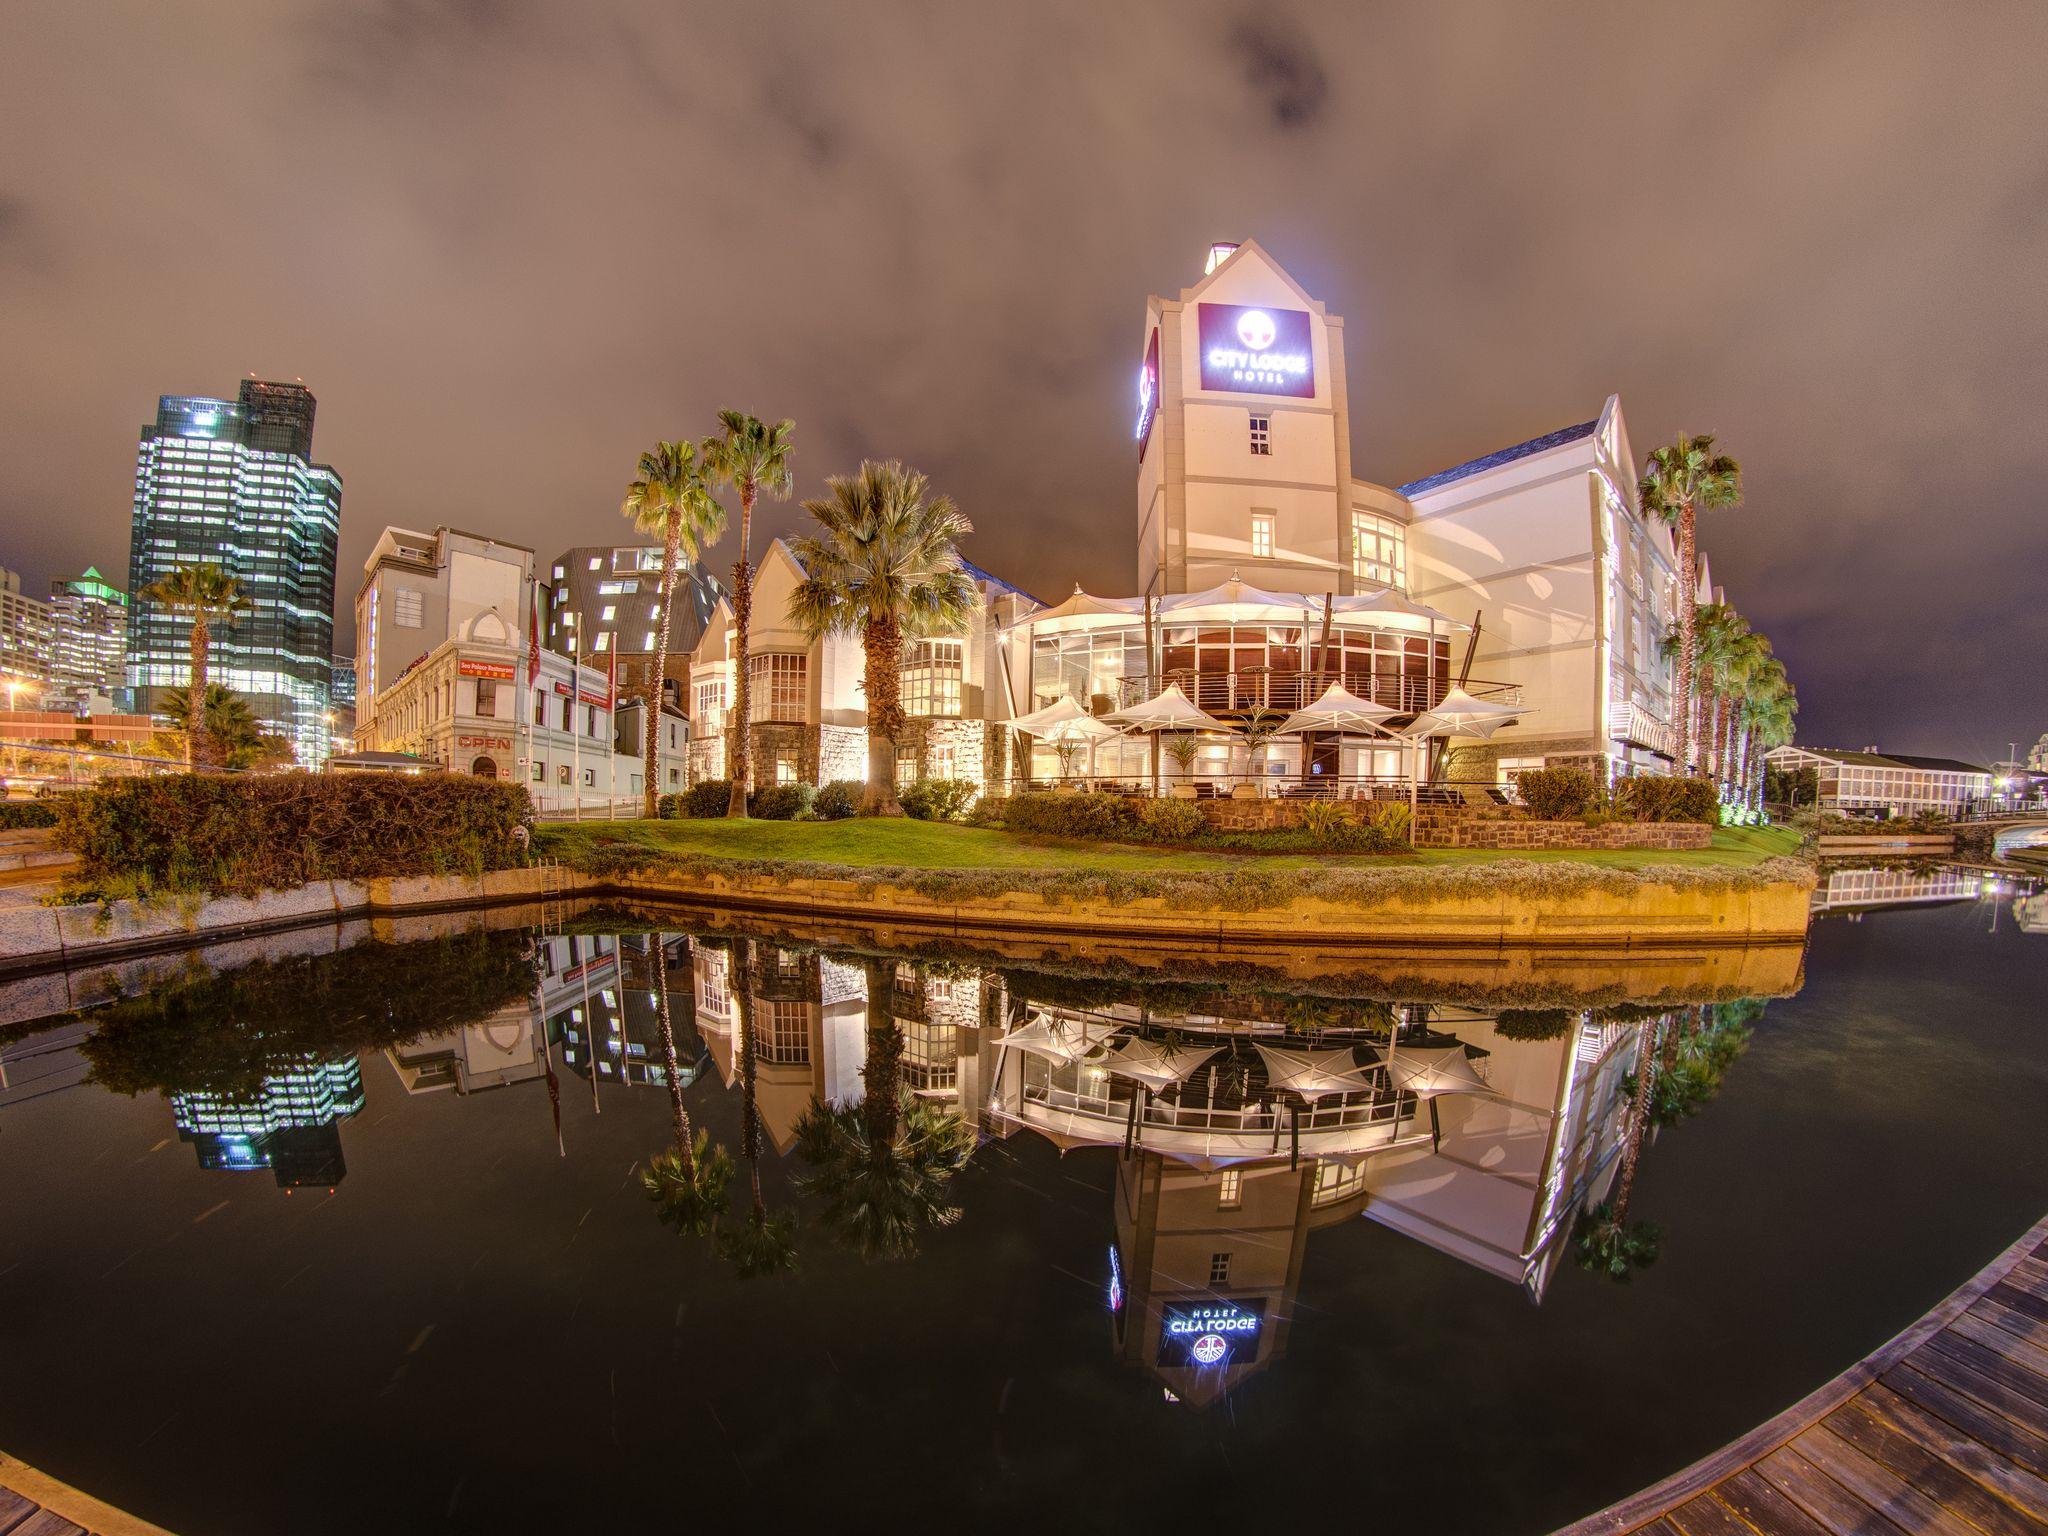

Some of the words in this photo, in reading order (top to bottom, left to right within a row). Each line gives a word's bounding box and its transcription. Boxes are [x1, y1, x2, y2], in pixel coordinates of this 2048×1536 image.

[1209, 349, 1248, 369] CITY
[1249, 352, 1306, 374] LODGE
[1233, 370, 1284, 384] HOTEL
[459, 736, 511, 750] OPEN
